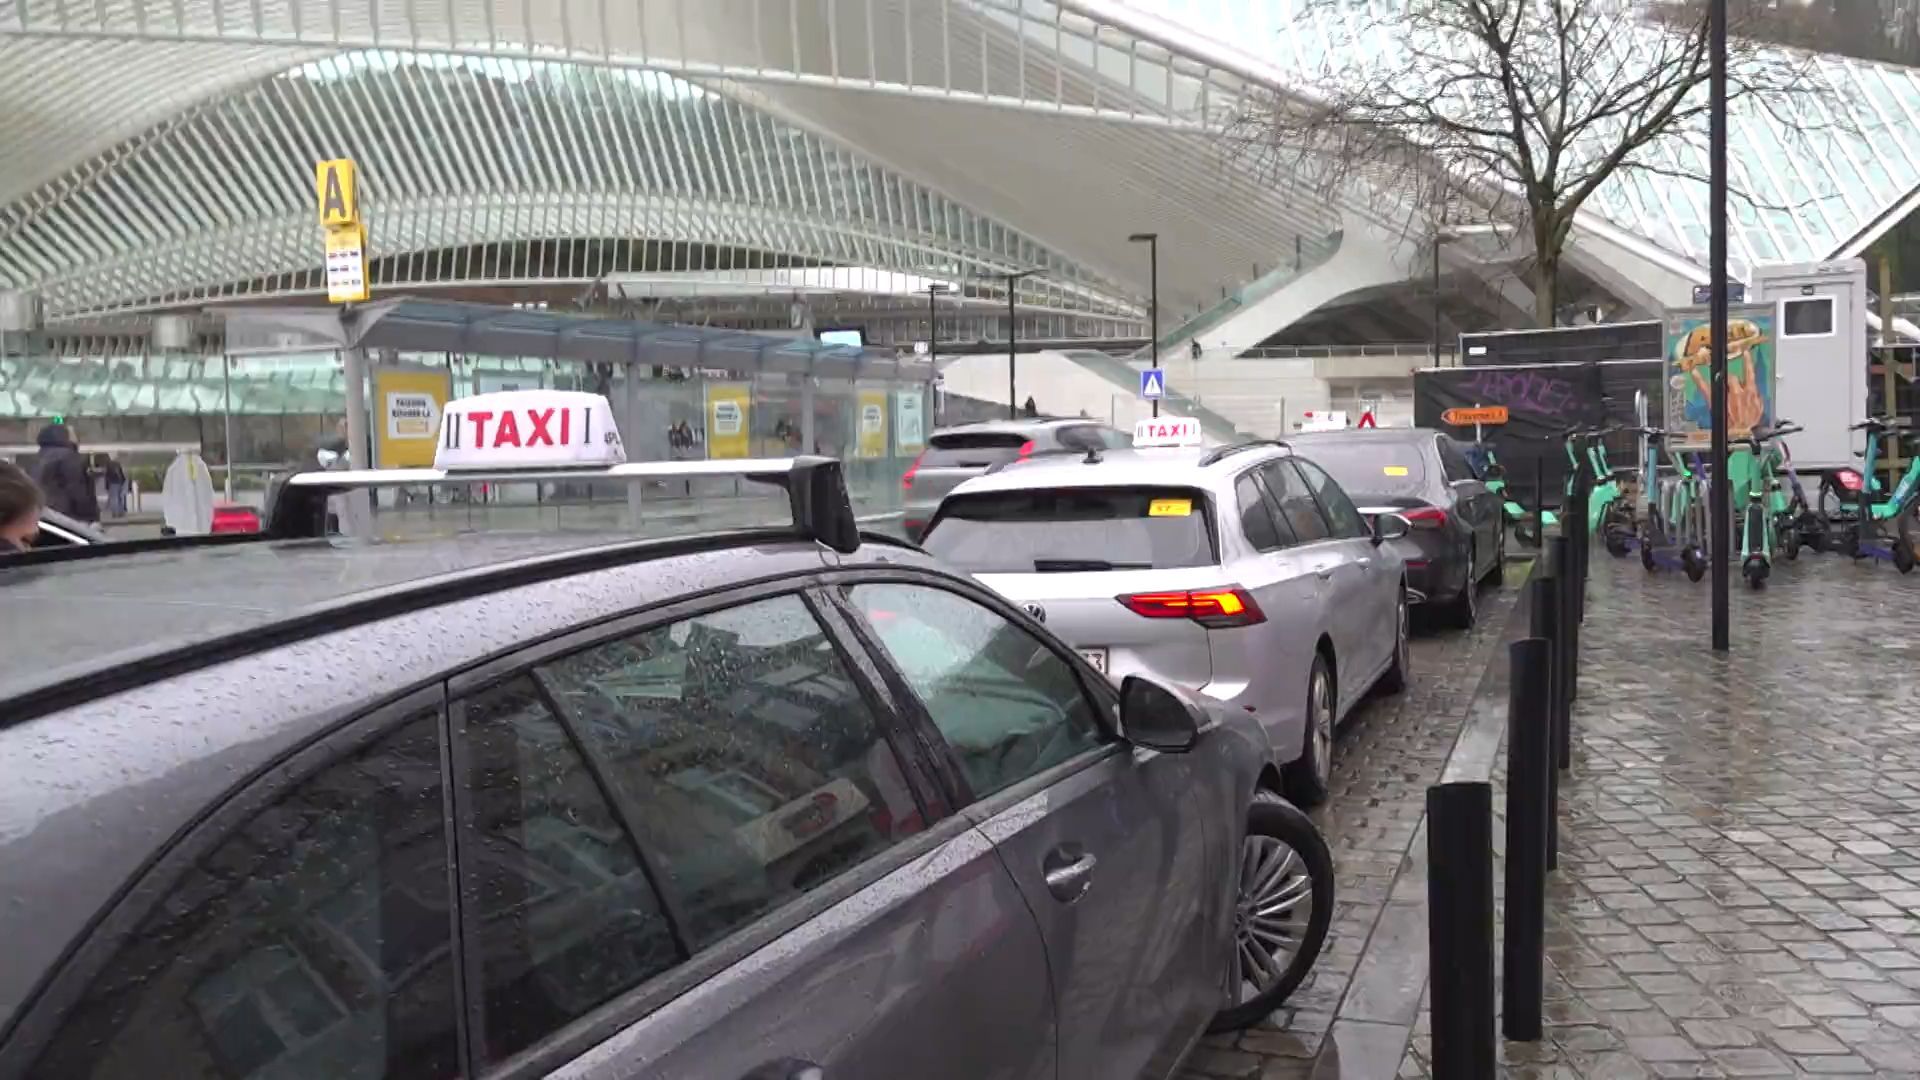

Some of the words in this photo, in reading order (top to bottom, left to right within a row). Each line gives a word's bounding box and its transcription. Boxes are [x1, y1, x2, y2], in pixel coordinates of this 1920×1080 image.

[323, 165, 347, 221] A
[467, 407, 570, 449] TAXI
[1146, 423, 1188, 438] TAXI
